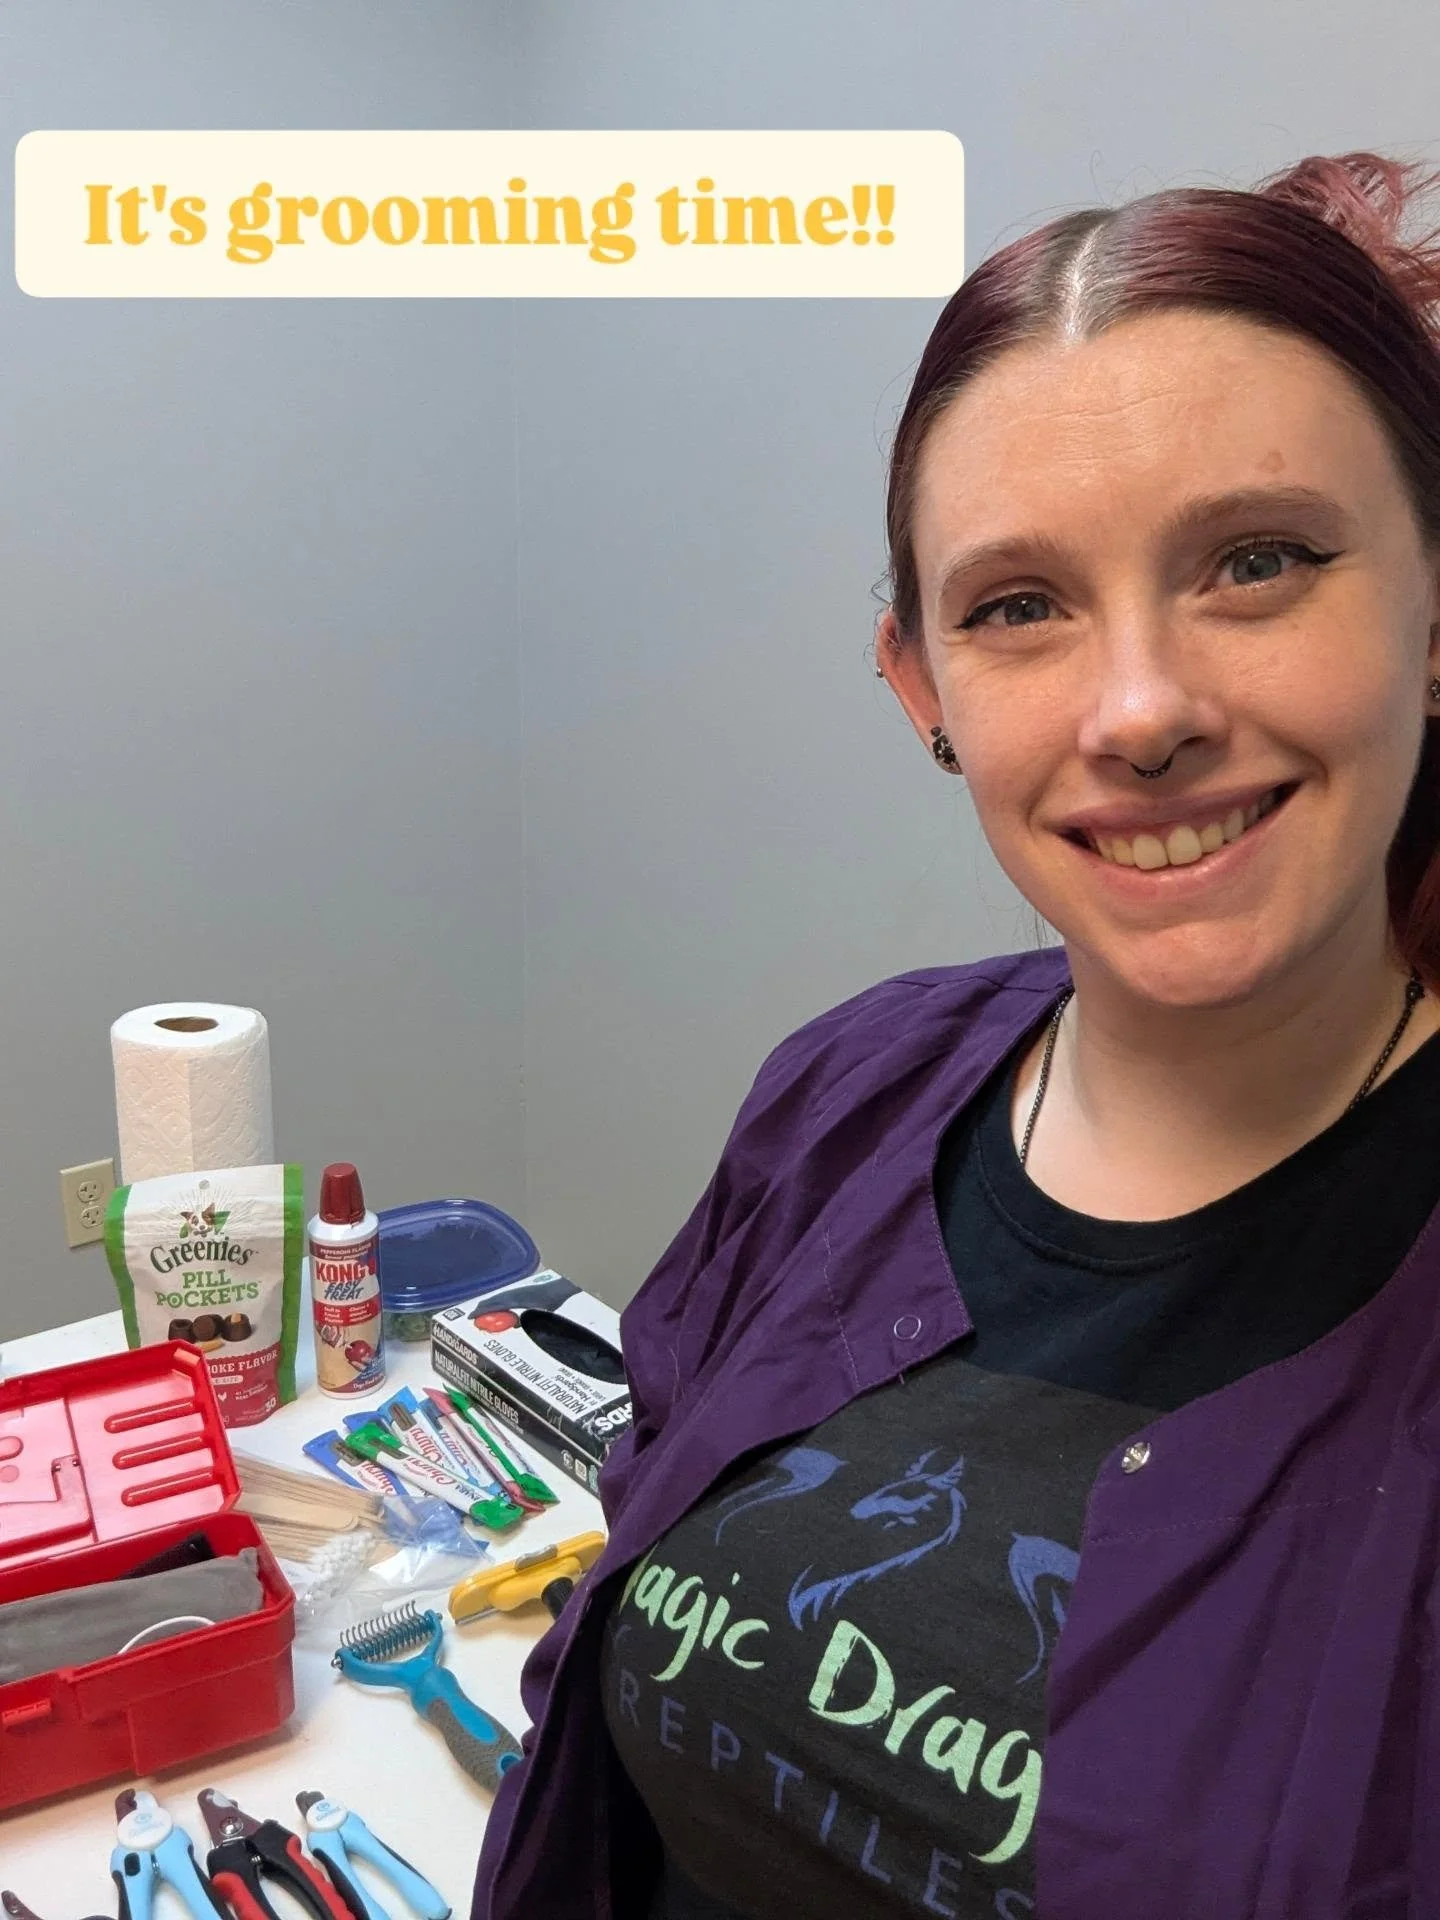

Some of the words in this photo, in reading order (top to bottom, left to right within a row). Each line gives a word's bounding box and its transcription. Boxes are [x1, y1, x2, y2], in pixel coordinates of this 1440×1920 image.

[150, 1236, 254, 1274] Greenies
[182, 1269, 232, 1289] PILL
[315, 1261, 366, 1283] KONG
[156, 1282, 260, 1308] POCKETS
[324, 1287, 364, 1301] TREAT
[327, 1280, 360, 1292] EASY
[238, 1350, 278, 1371] FLAVOR
[485, 1339, 517, 1362] GLOVES
[510, 1358, 545, 1385] NITRILE
[469, 1380, 494, 1405] NITRILE
[494, 1396, 519, 1424] GLOVES
[535, 1375, 588, 1414] NATURALFIT
